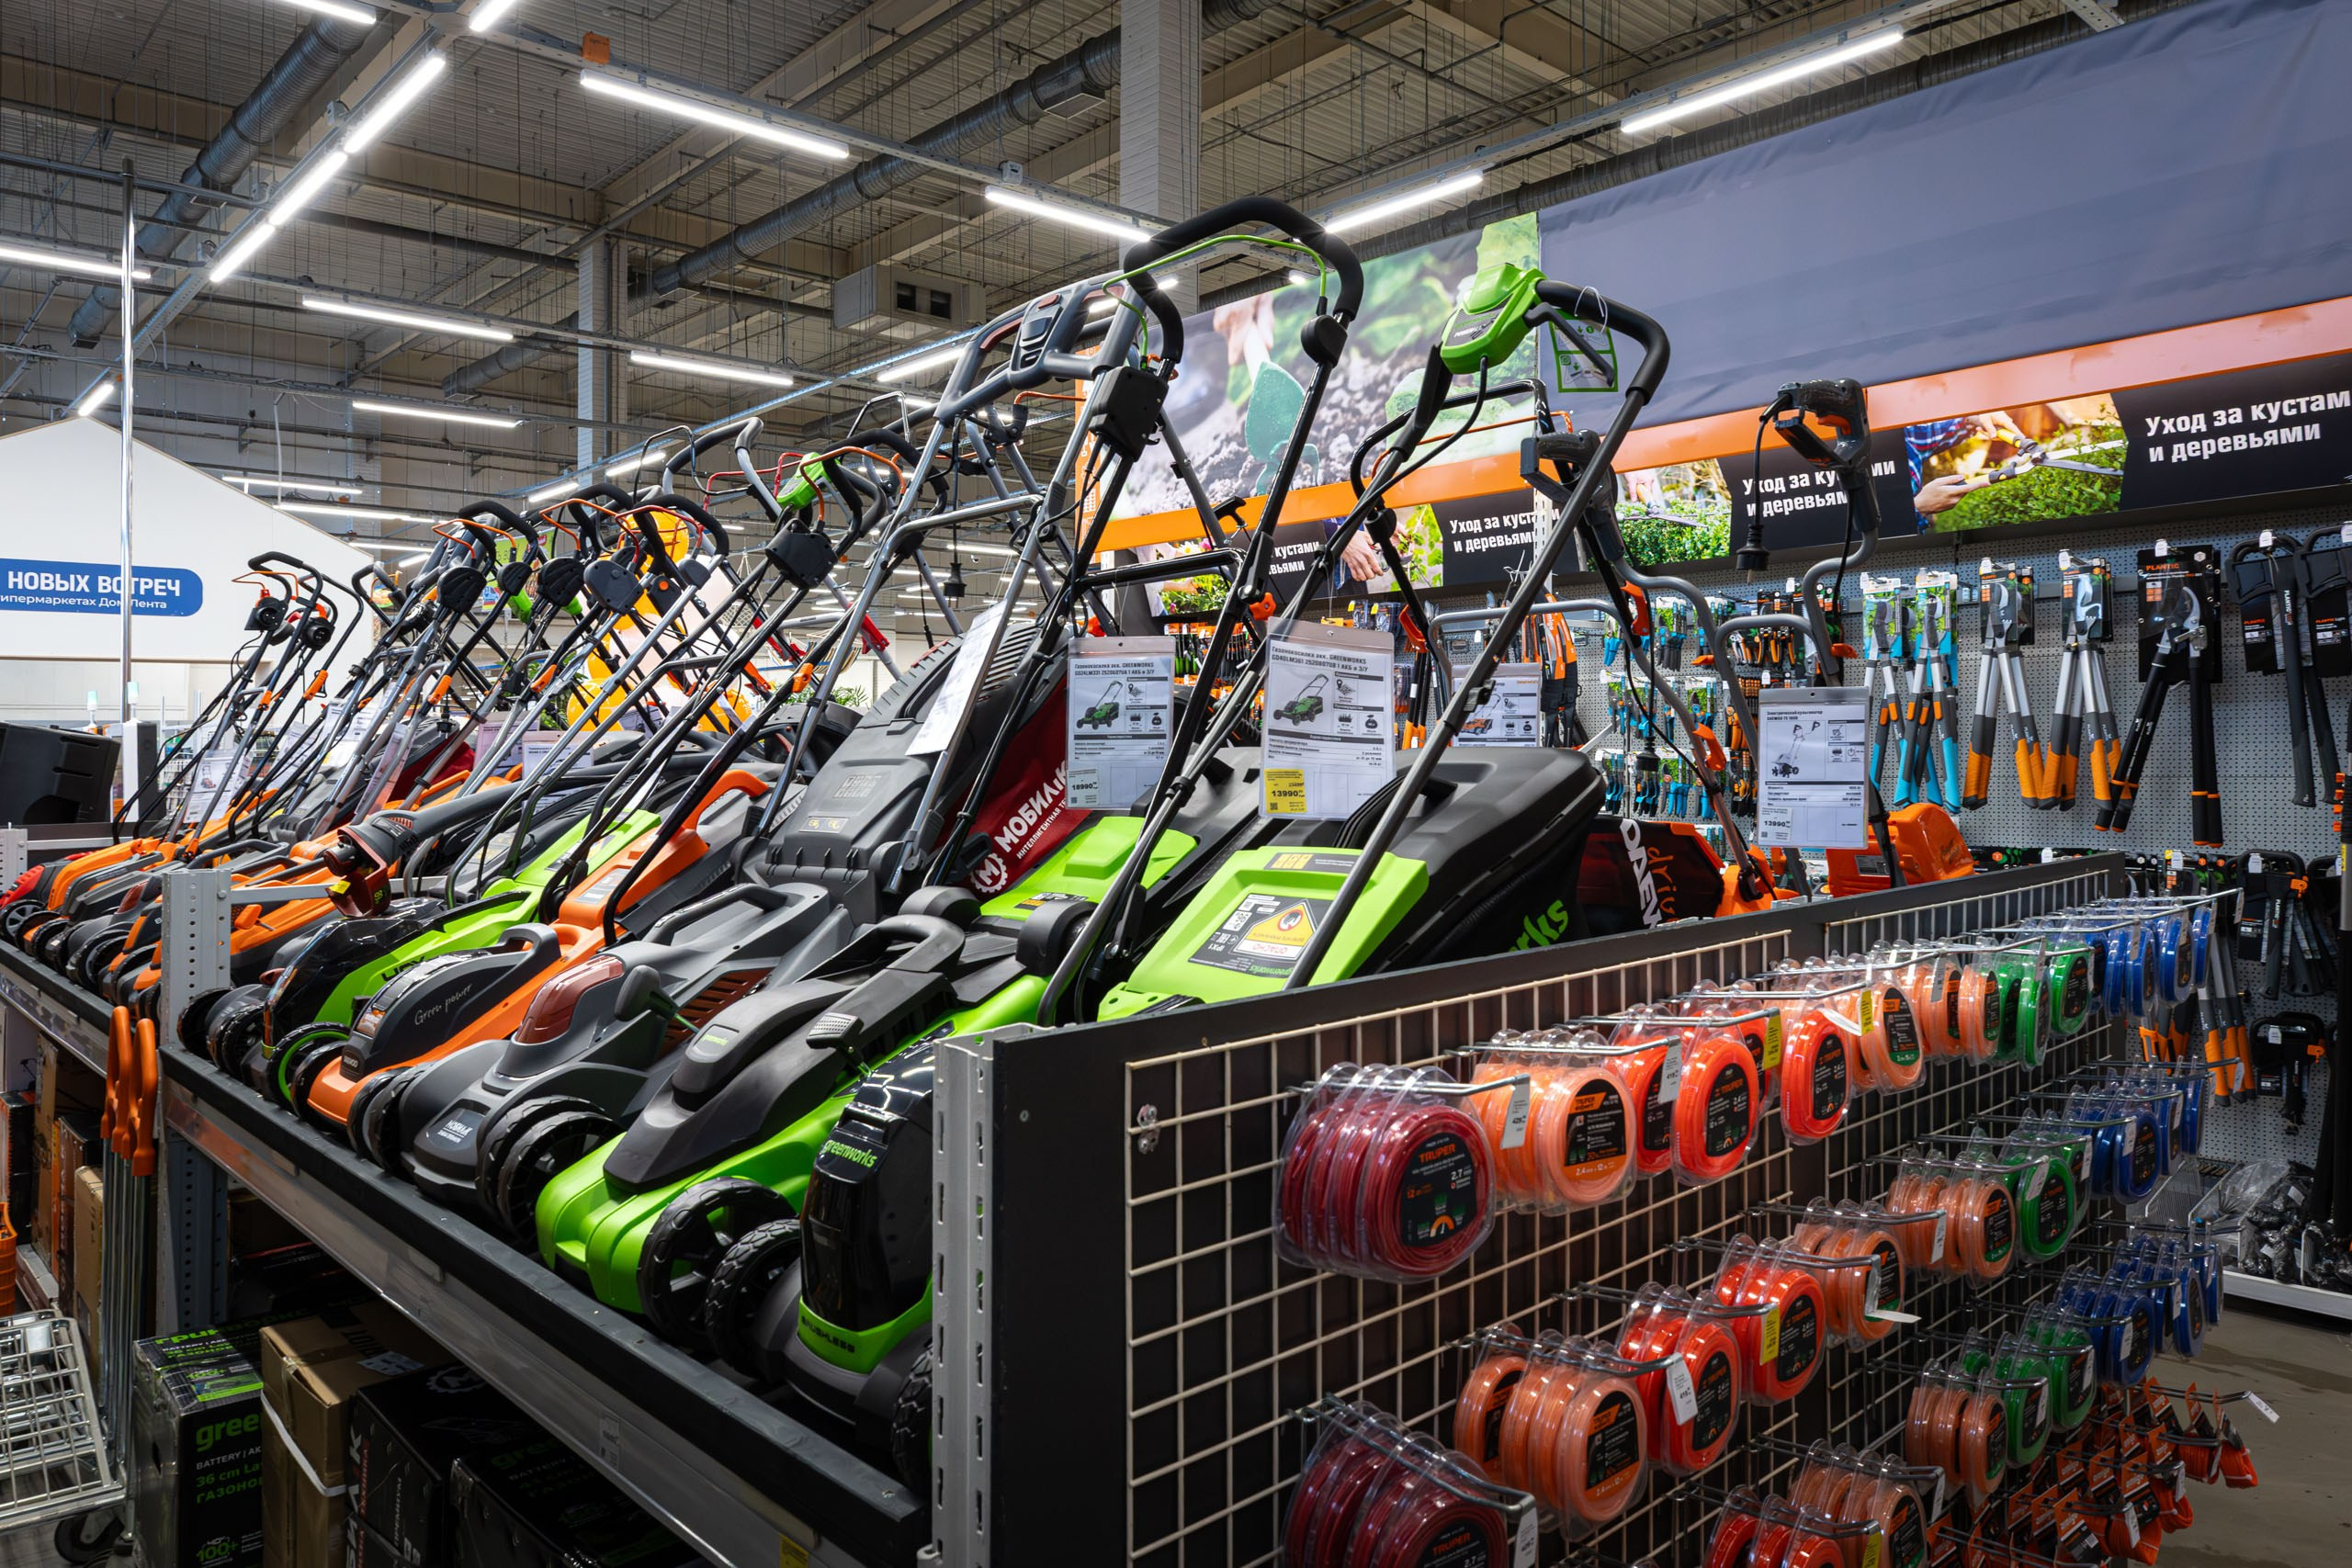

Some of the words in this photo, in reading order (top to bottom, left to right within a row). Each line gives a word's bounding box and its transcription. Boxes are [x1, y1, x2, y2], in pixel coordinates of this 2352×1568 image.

[2144, 412, 2207, 437] Уход
[2212, 407, 2244, 427] за
[2250, 389, 2352, 423] кустам
[2149, 446, 2165, 463] и
[2171, 423, 2322, 463] деревьями
[1789, 473, 1810, 490] за
[1815, 460, 1896, 487] куми
[1762, 491, 1849, 518] деревьям
[1450, 518, 1482, 535] Уход
[1484, 515, 1501, 530] за
[1502, 508, 1560, 529] кустаи
[1274, 541, 1319, 558] кустами
[1453, 540, 1463, 553] и
[1465, 531, 1535, 553] деревьям
[2145, 562, 2180, 571] PLANTIC
[7, 570, 90, 592] НОВЫХ
[0, 594, 96, 606] ипермаркетах
[1271, 646, 1315, 660] Газонокосилка
[1329, 653, 1367, 664] GREENWORKS
[1015, 807, 1062, 860] ИНТЕЛЛИГЕНТНАЯ
[1619, 818, 1663, 930] DAEW
[1646, 846, 1679, 924] driv
[1207, 943, 1225, 952] IPX1
[413, 1003, 442, 1026] Green
[445, 983, 473, 1013] power
[820, 1139, 877, 1168] greenworks
[1419, 1143, 1456, 1163] TRUPER
[195, 1413, 261, 1453] gree
[196, 1450, 242, 1471] BATTERY
[196, 1473, 215, 1489] 36
[219, 1468, 241, 1481] cm
[1432, 1532, 1471, 1558] TRUPER
